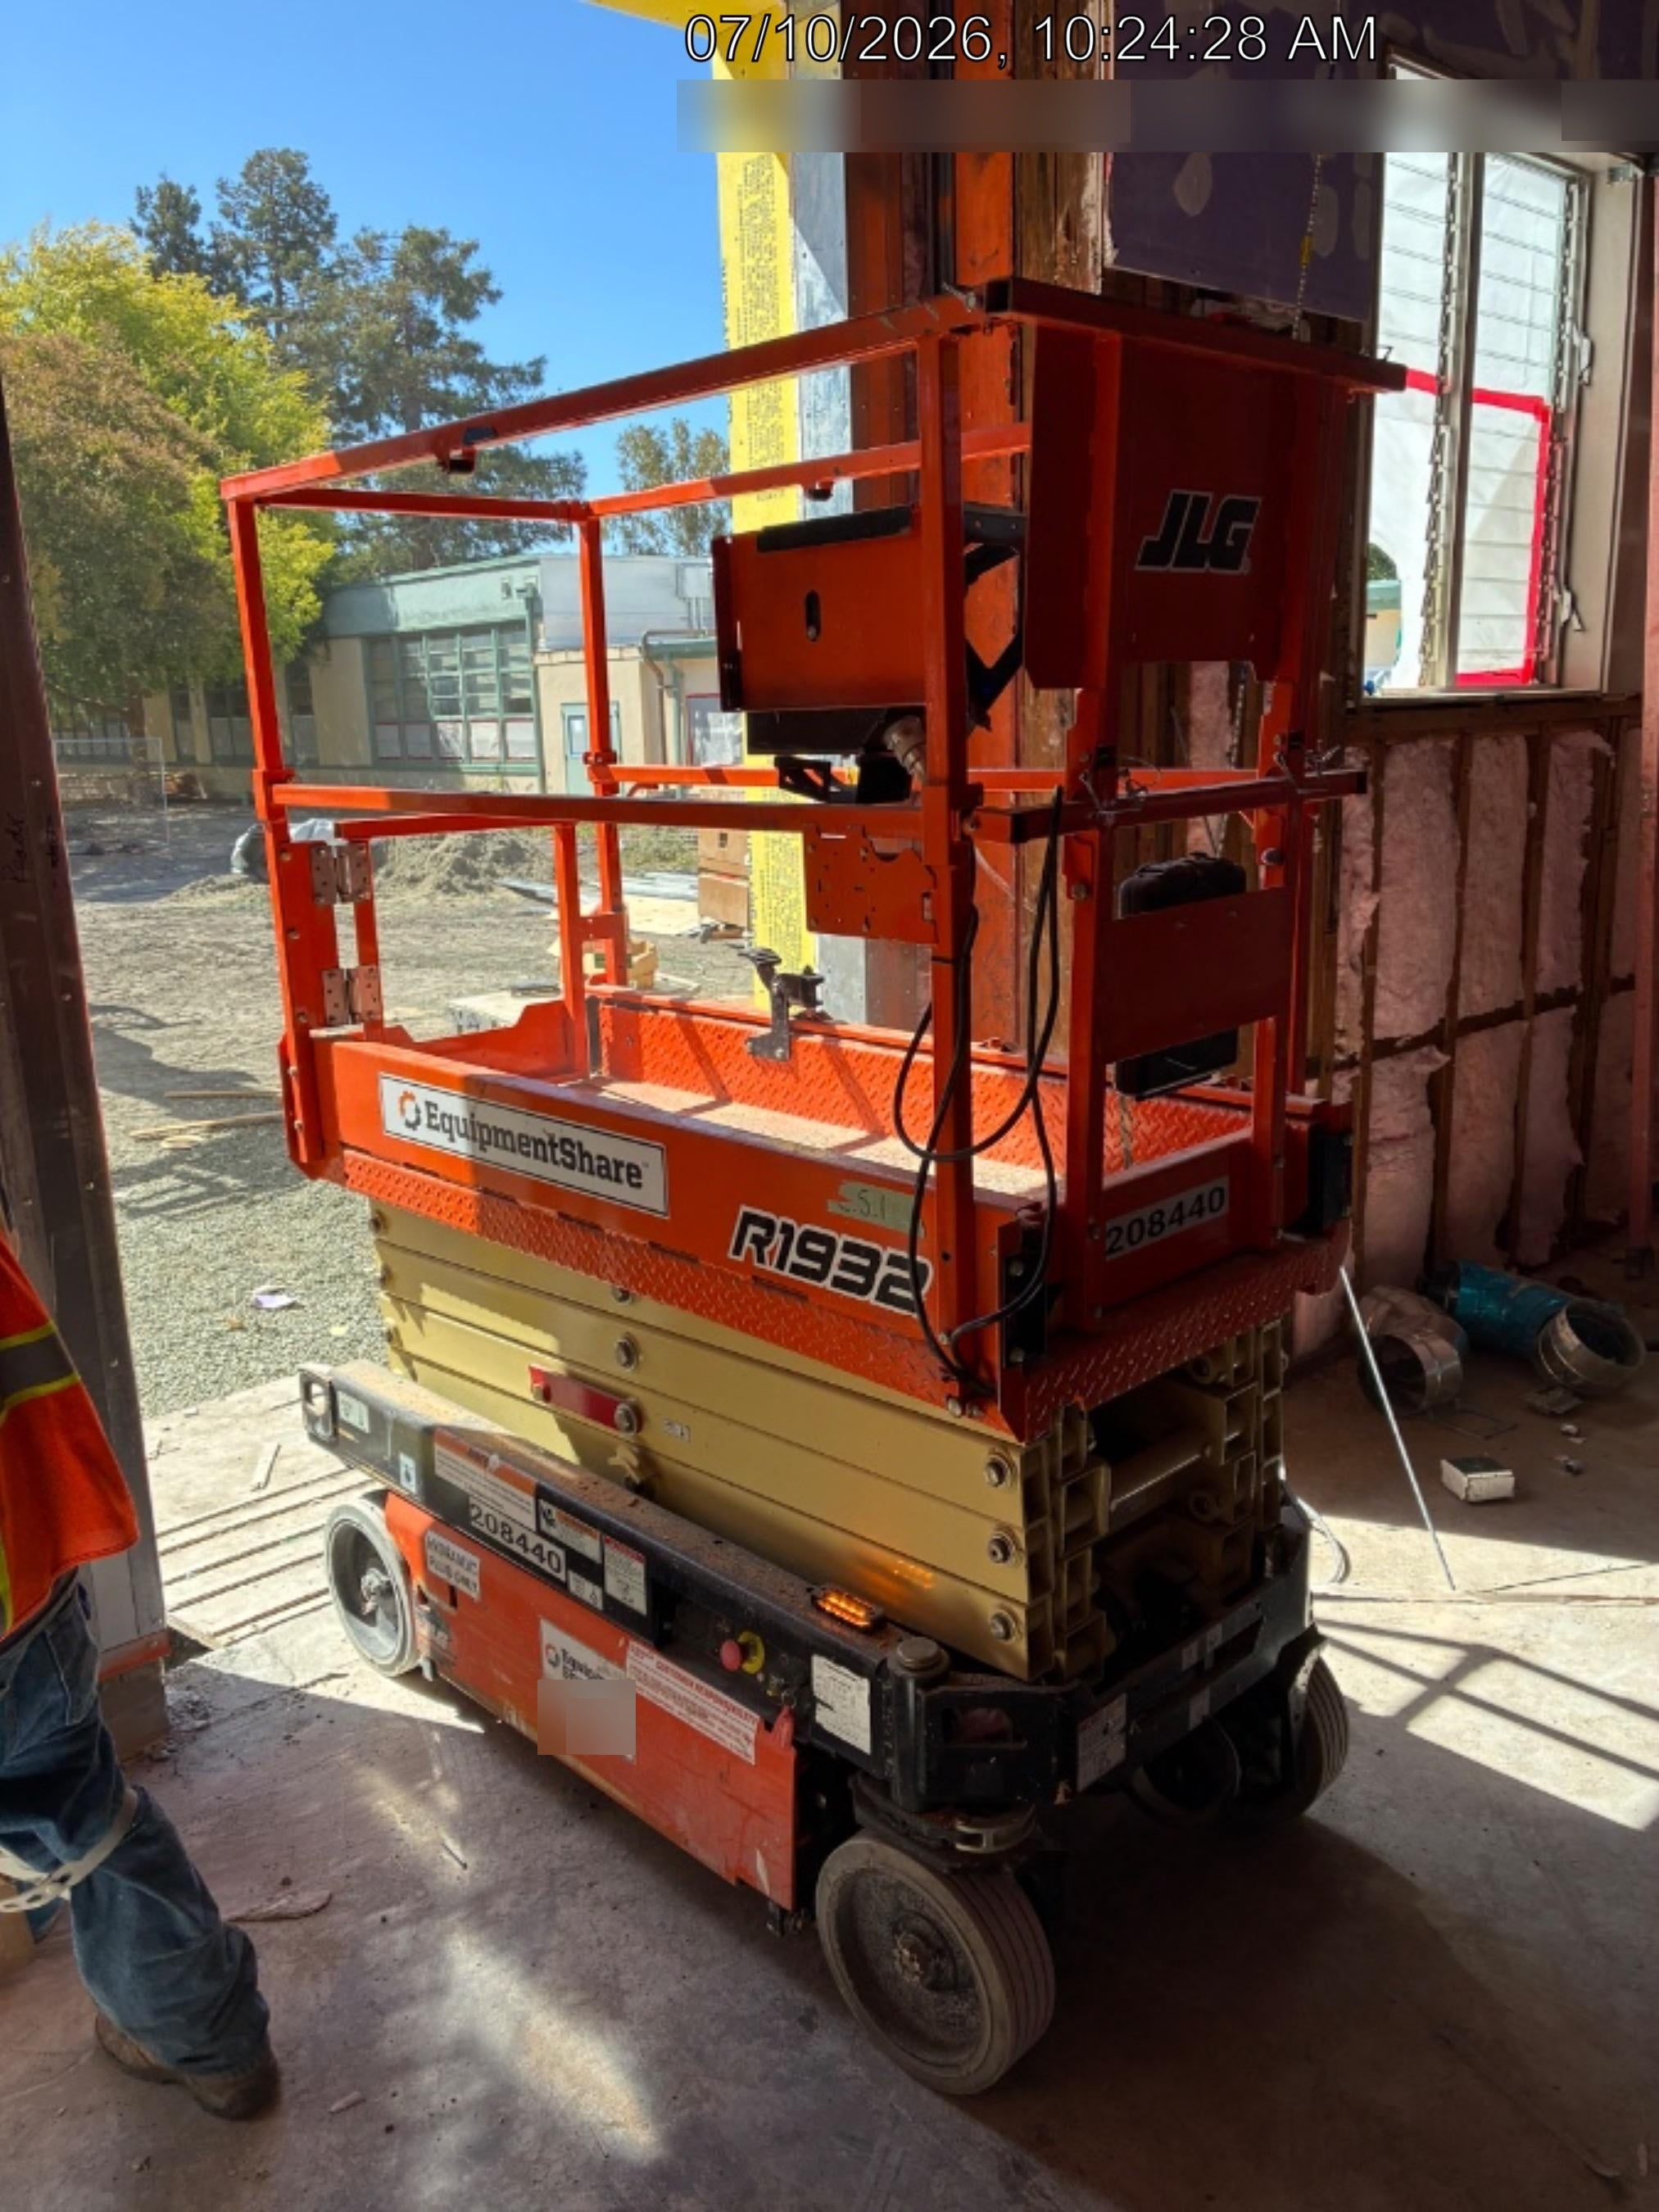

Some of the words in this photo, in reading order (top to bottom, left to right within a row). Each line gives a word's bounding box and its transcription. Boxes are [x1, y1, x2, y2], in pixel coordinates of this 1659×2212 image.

[1135, 489, 1262, 575] JLG
[424, 1099, 644, 1189] EquipmentShare
[728, 1204, 935, 1318] R1932
[1106, 1185, 1226, 1254] 208440
[470, 1503, 562, 1575] 208440
